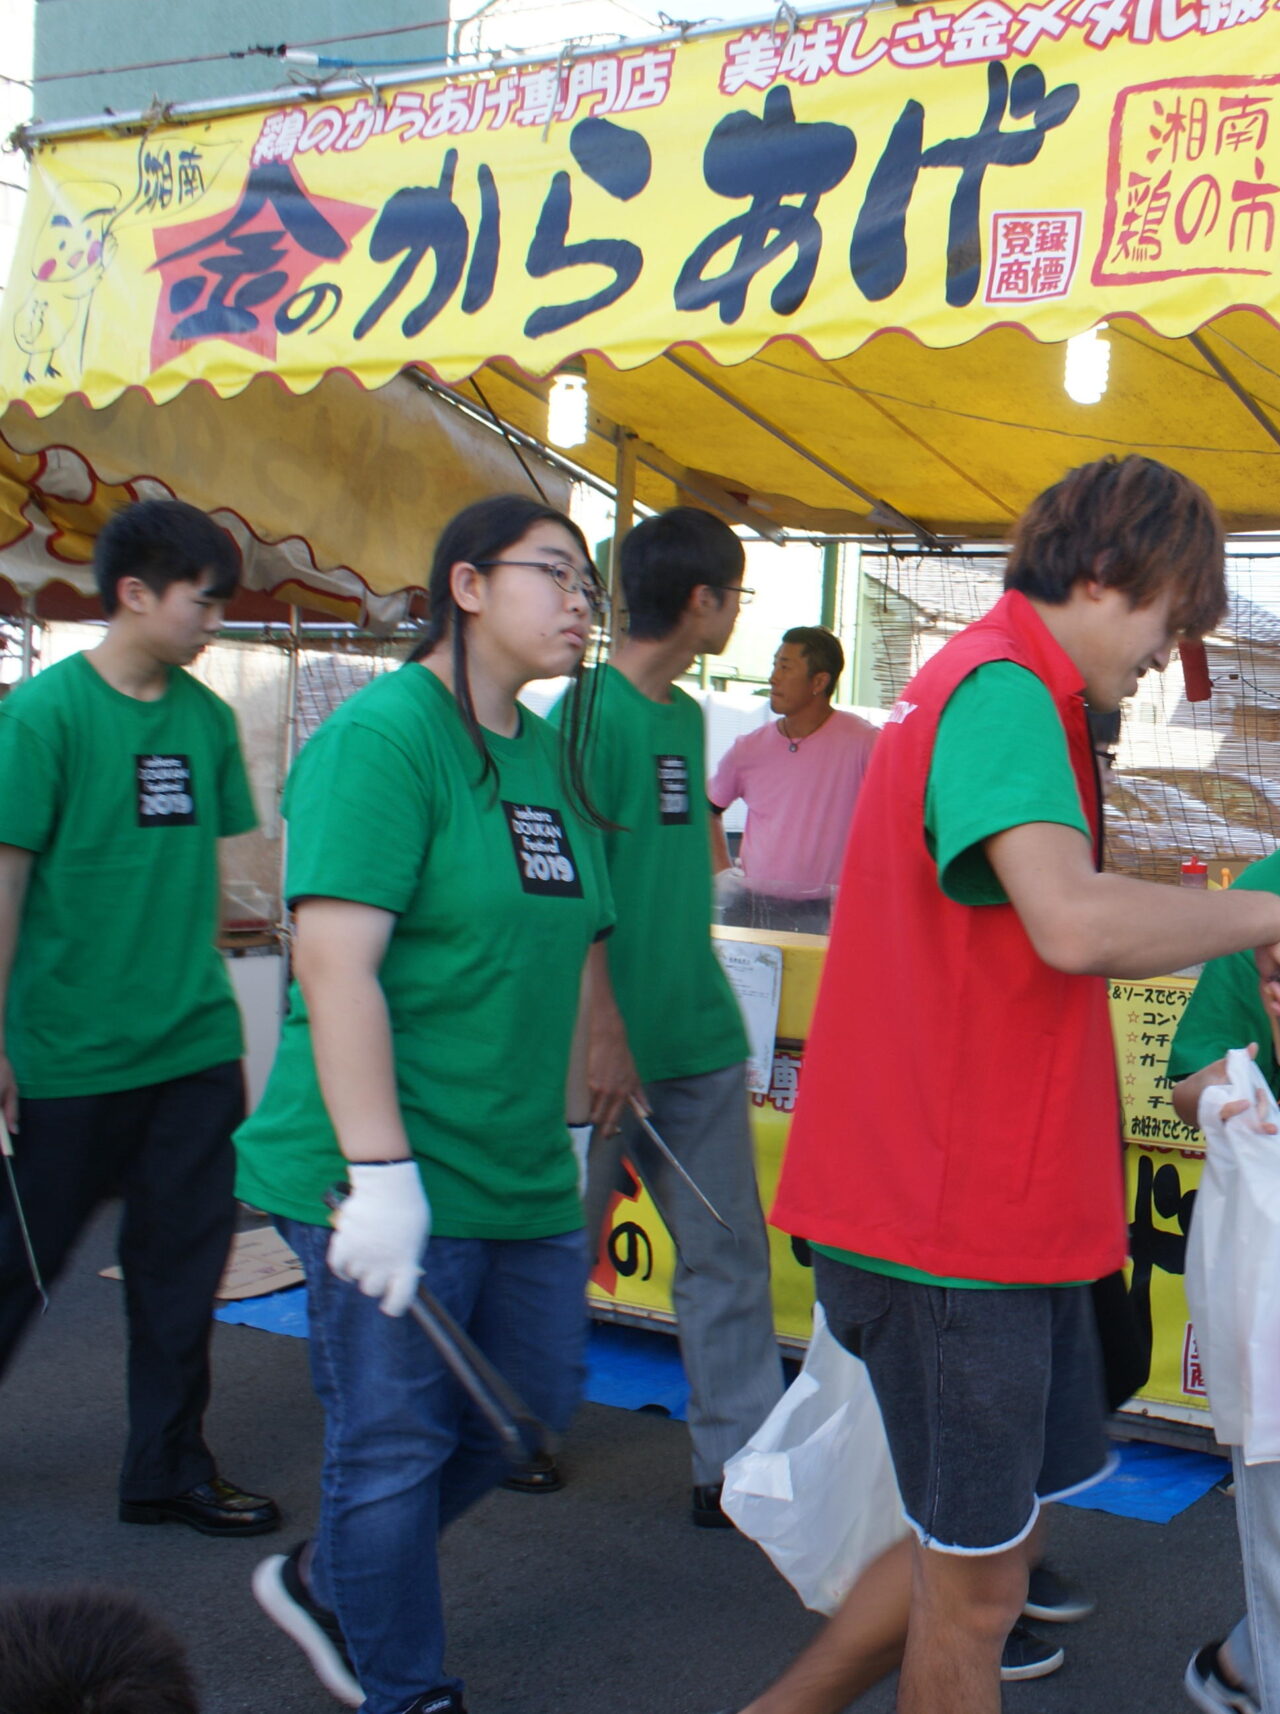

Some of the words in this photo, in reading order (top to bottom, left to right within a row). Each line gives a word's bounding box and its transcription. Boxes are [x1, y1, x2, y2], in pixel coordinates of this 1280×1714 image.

[249, 49, 675, 165] 鶏のからあげ専門店
[1146, 93, 1274, 164] 湘南
[146, 61, 1080, 341] 金のからあげ
[1000, 219, 1069, 258] 登録
[996, 254, 1065, 295] 商標
[519, 850, 575, 882] 2019
[1141, 1032, 1170, 1047] ケチ
[1140, 1053, 1169, 1067] ガー
